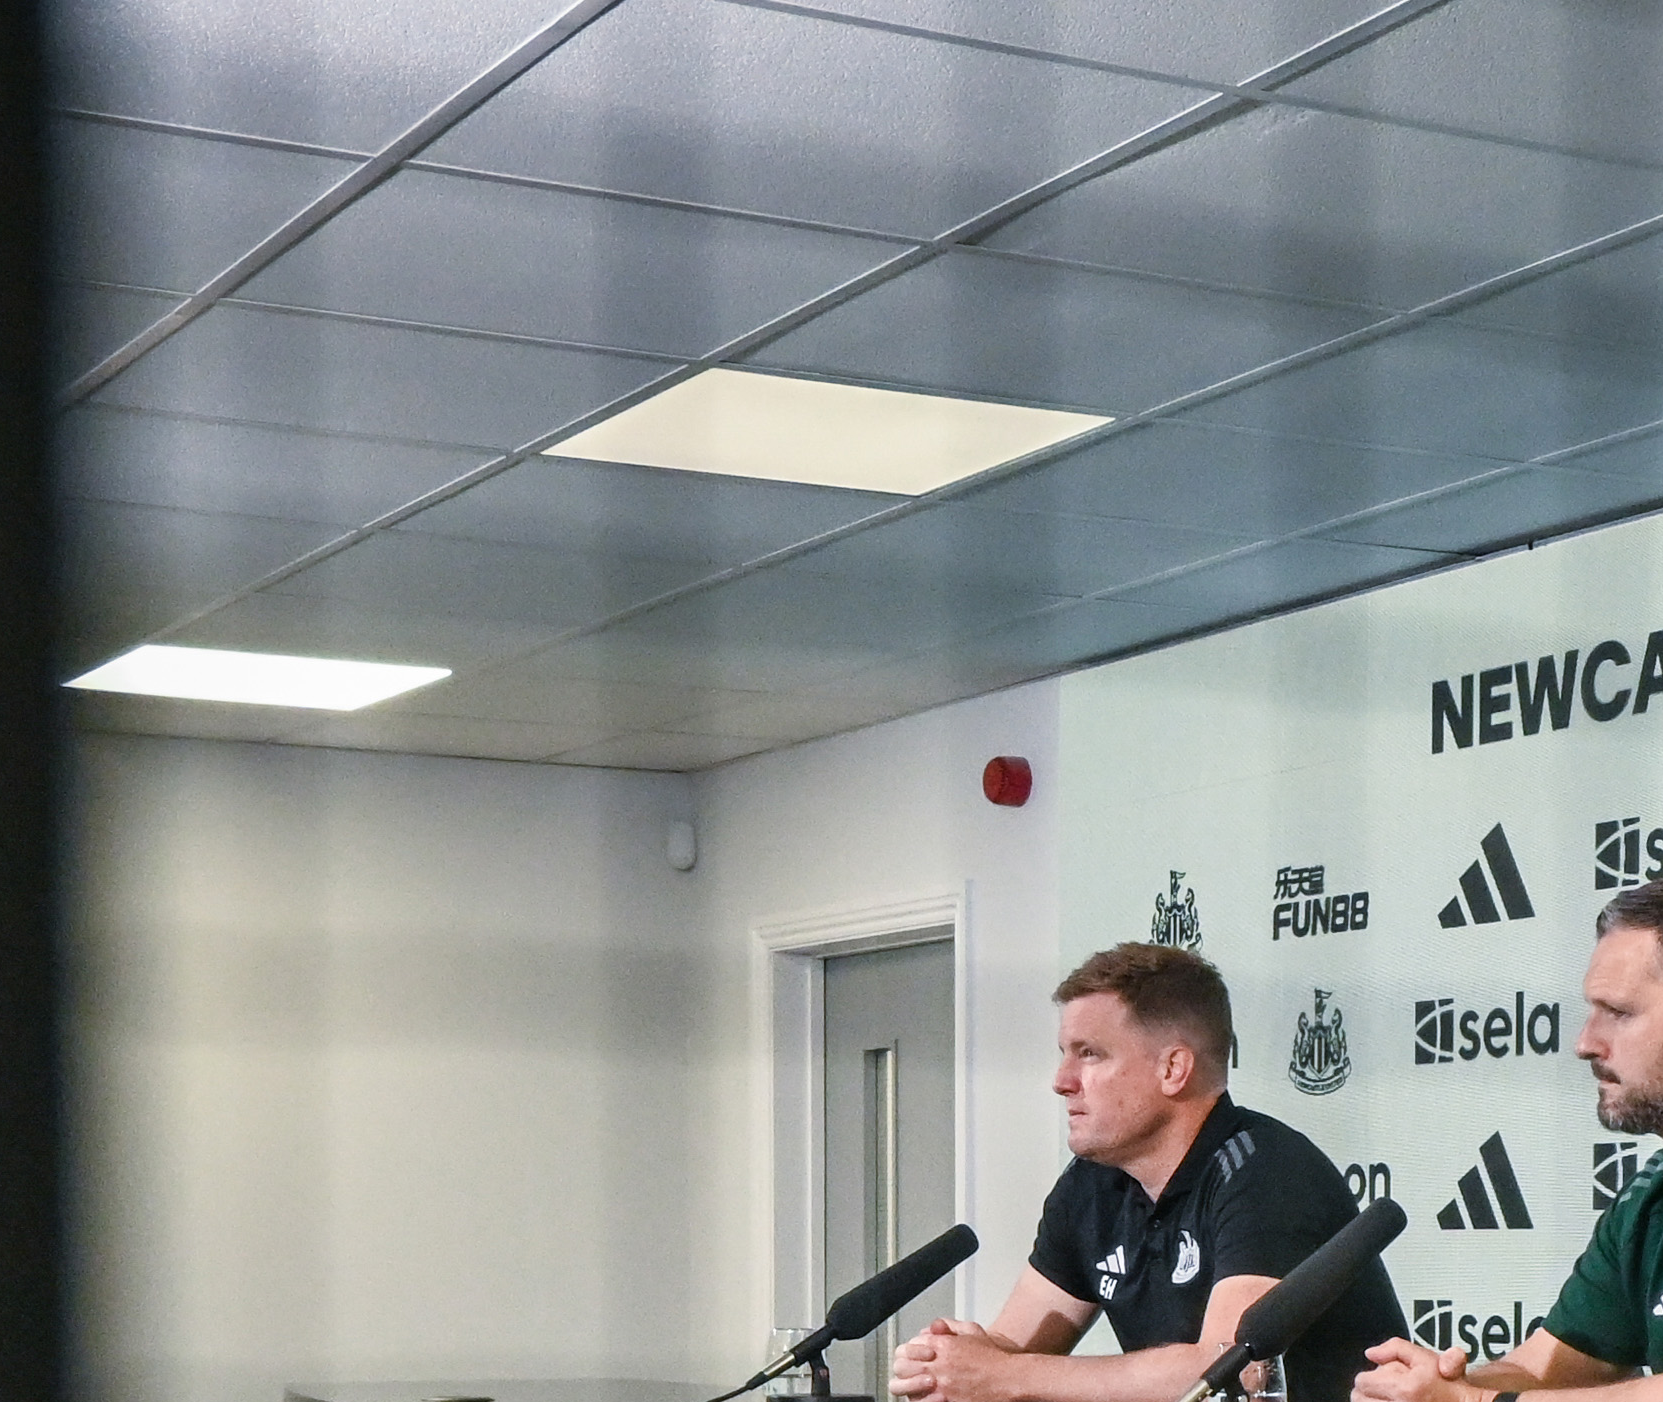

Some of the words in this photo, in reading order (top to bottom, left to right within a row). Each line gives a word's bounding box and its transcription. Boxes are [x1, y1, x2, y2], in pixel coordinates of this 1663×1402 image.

[1272, 890, 1370, 941] FUN88
[1458, 991, 1560, 1061] sela
[1098, 1274, 1118, 1301] EH
